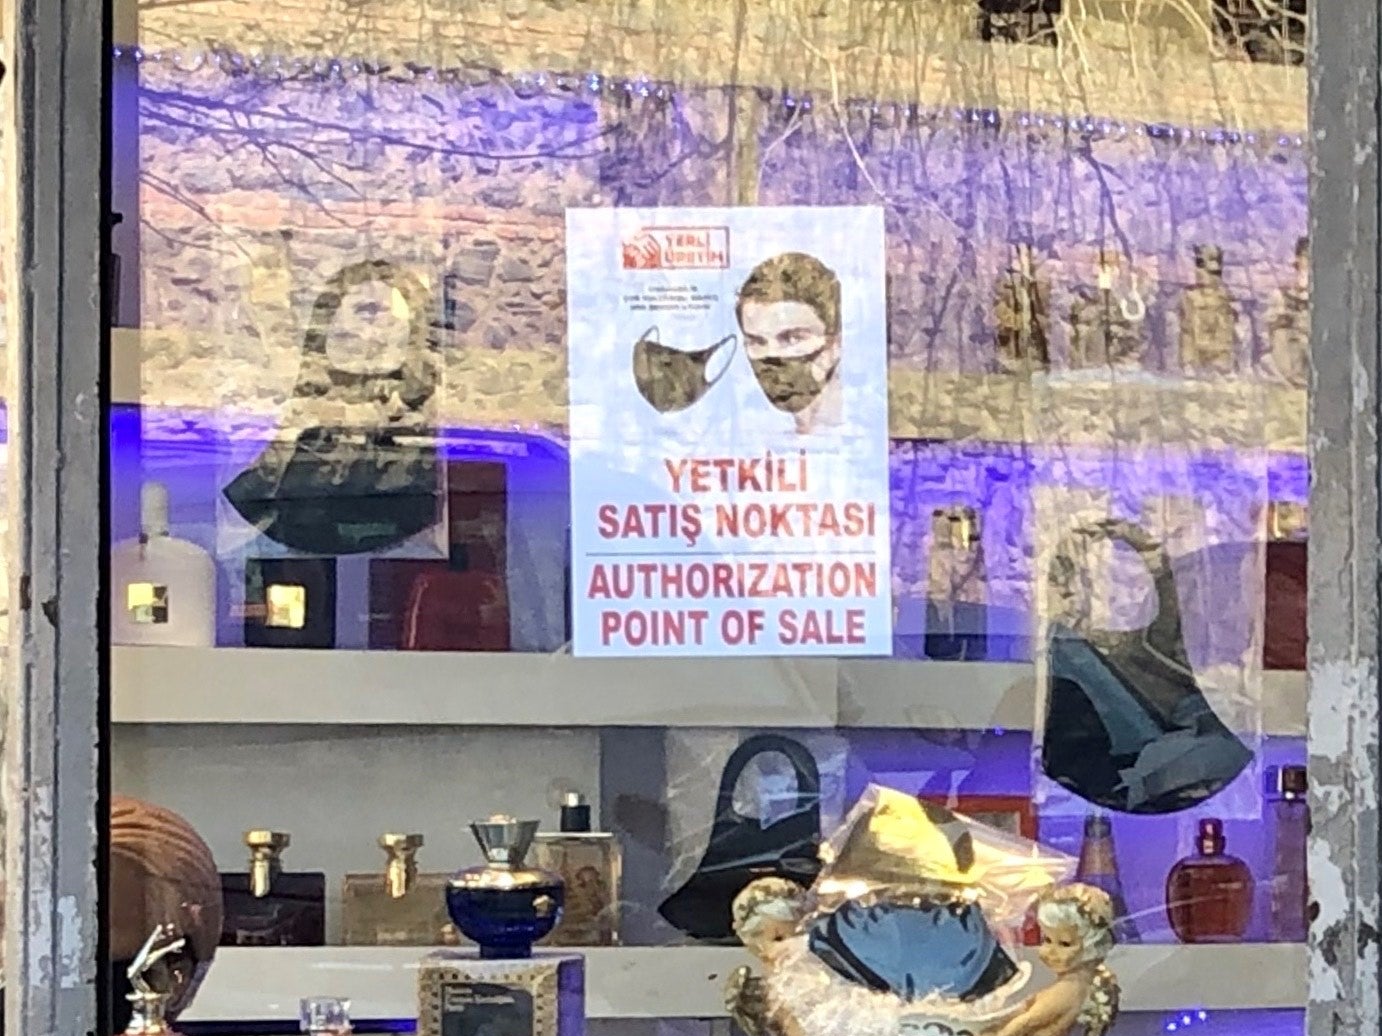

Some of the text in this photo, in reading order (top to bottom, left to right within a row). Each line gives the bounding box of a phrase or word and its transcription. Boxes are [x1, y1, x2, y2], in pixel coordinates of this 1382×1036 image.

[665, 448, 808, 494] YETKİLİ
[598, 502, 877, 547] SATIŞ NOKTASI
[588, 561, 878, 600] AUTHORIZATION
[602, 608, 867, 647] POINT OF SALE
